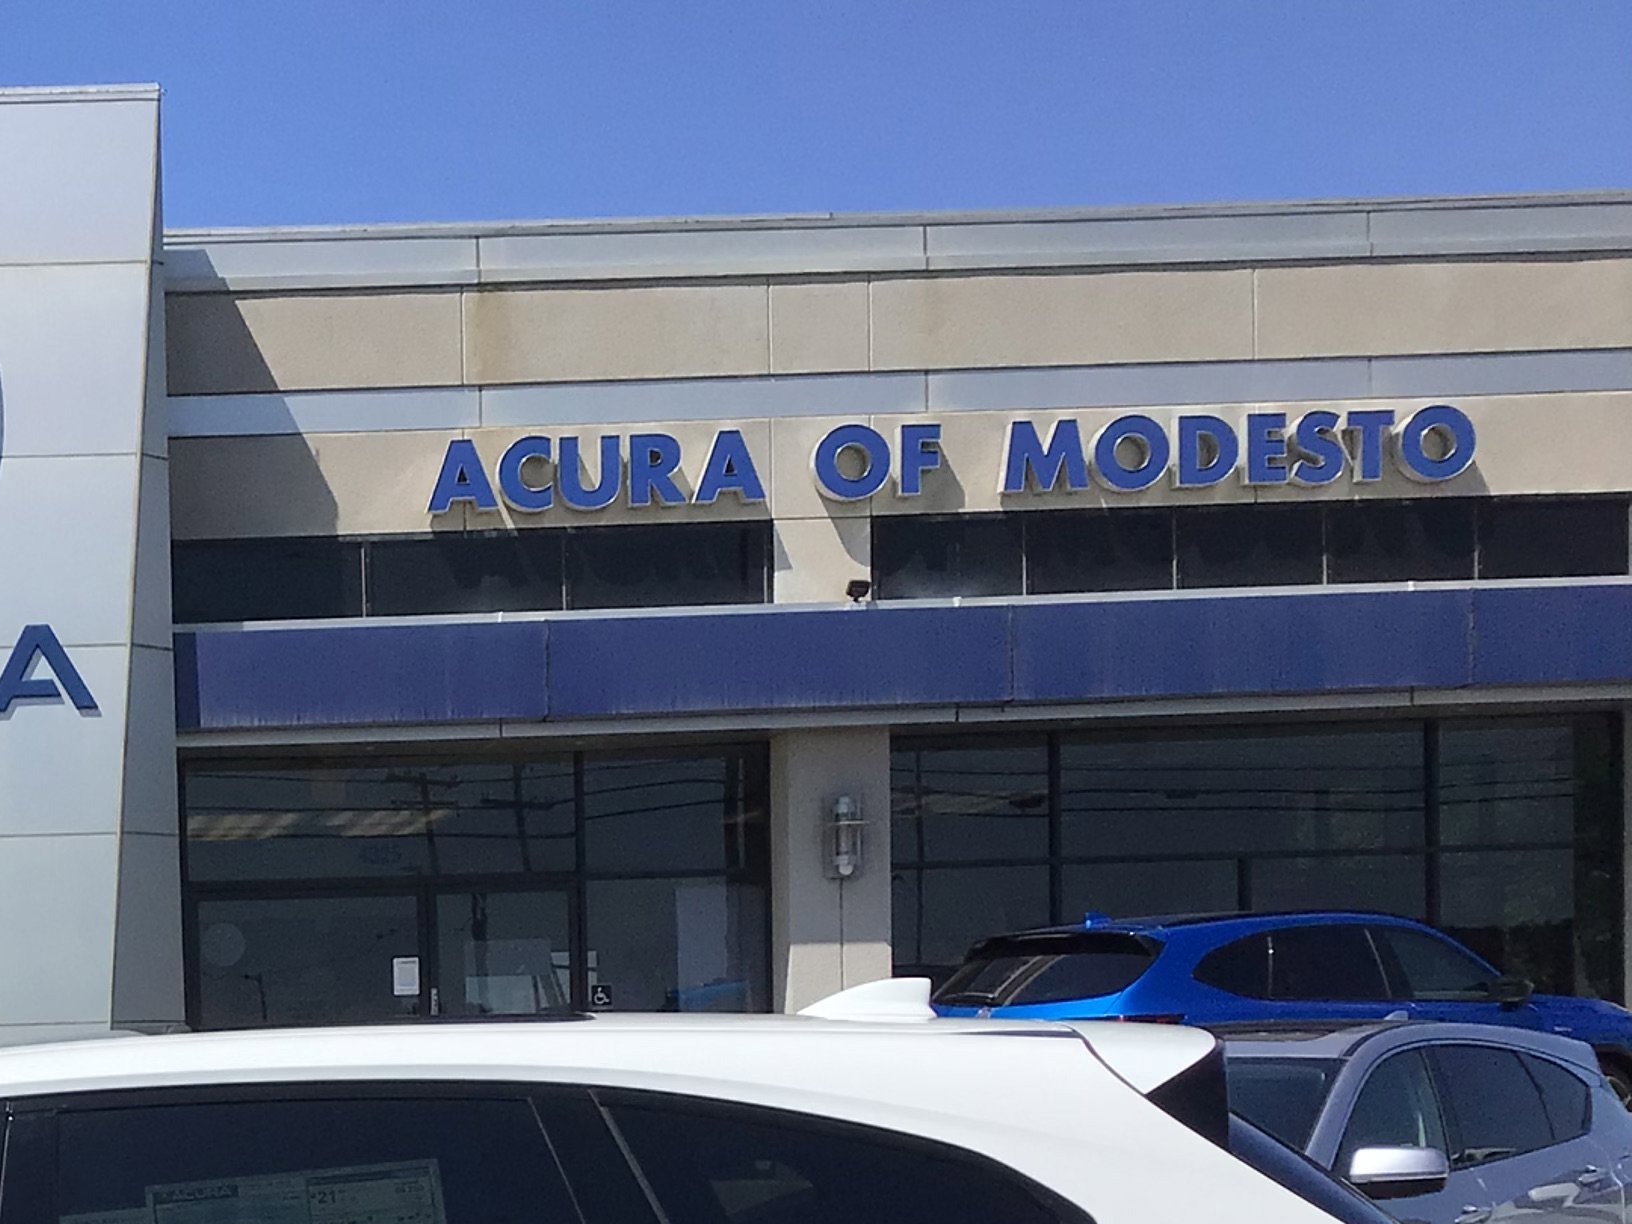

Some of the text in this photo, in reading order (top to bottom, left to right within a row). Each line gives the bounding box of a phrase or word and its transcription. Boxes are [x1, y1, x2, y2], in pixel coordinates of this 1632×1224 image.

[428, 406, 1476, 511] ACURA OF MODESTO
[172, 1184, 232, 1199] ACURA
